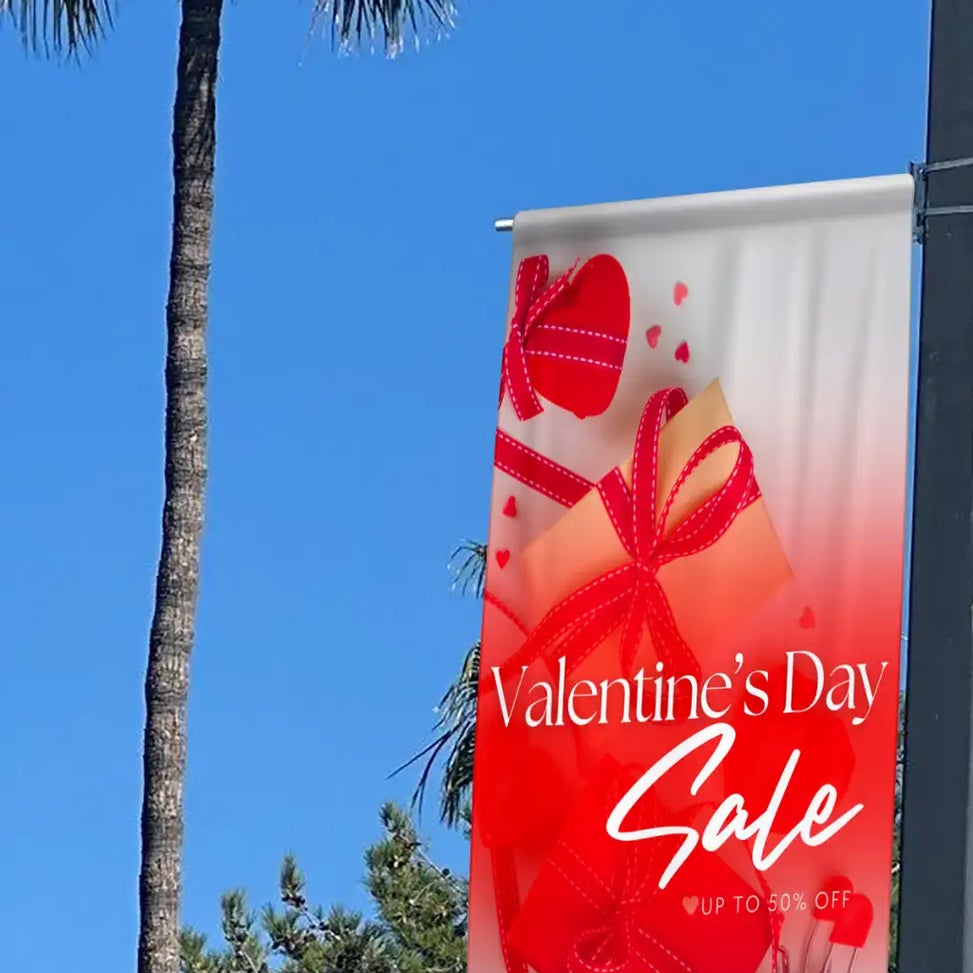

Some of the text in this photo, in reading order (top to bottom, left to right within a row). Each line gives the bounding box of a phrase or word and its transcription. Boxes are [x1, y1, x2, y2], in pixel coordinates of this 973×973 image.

[490, 650, 889, 728] Valentine's Day
[606, 722, 864, 889] Sale
[701, 890, 850, 916] UP TO 50% OFF
